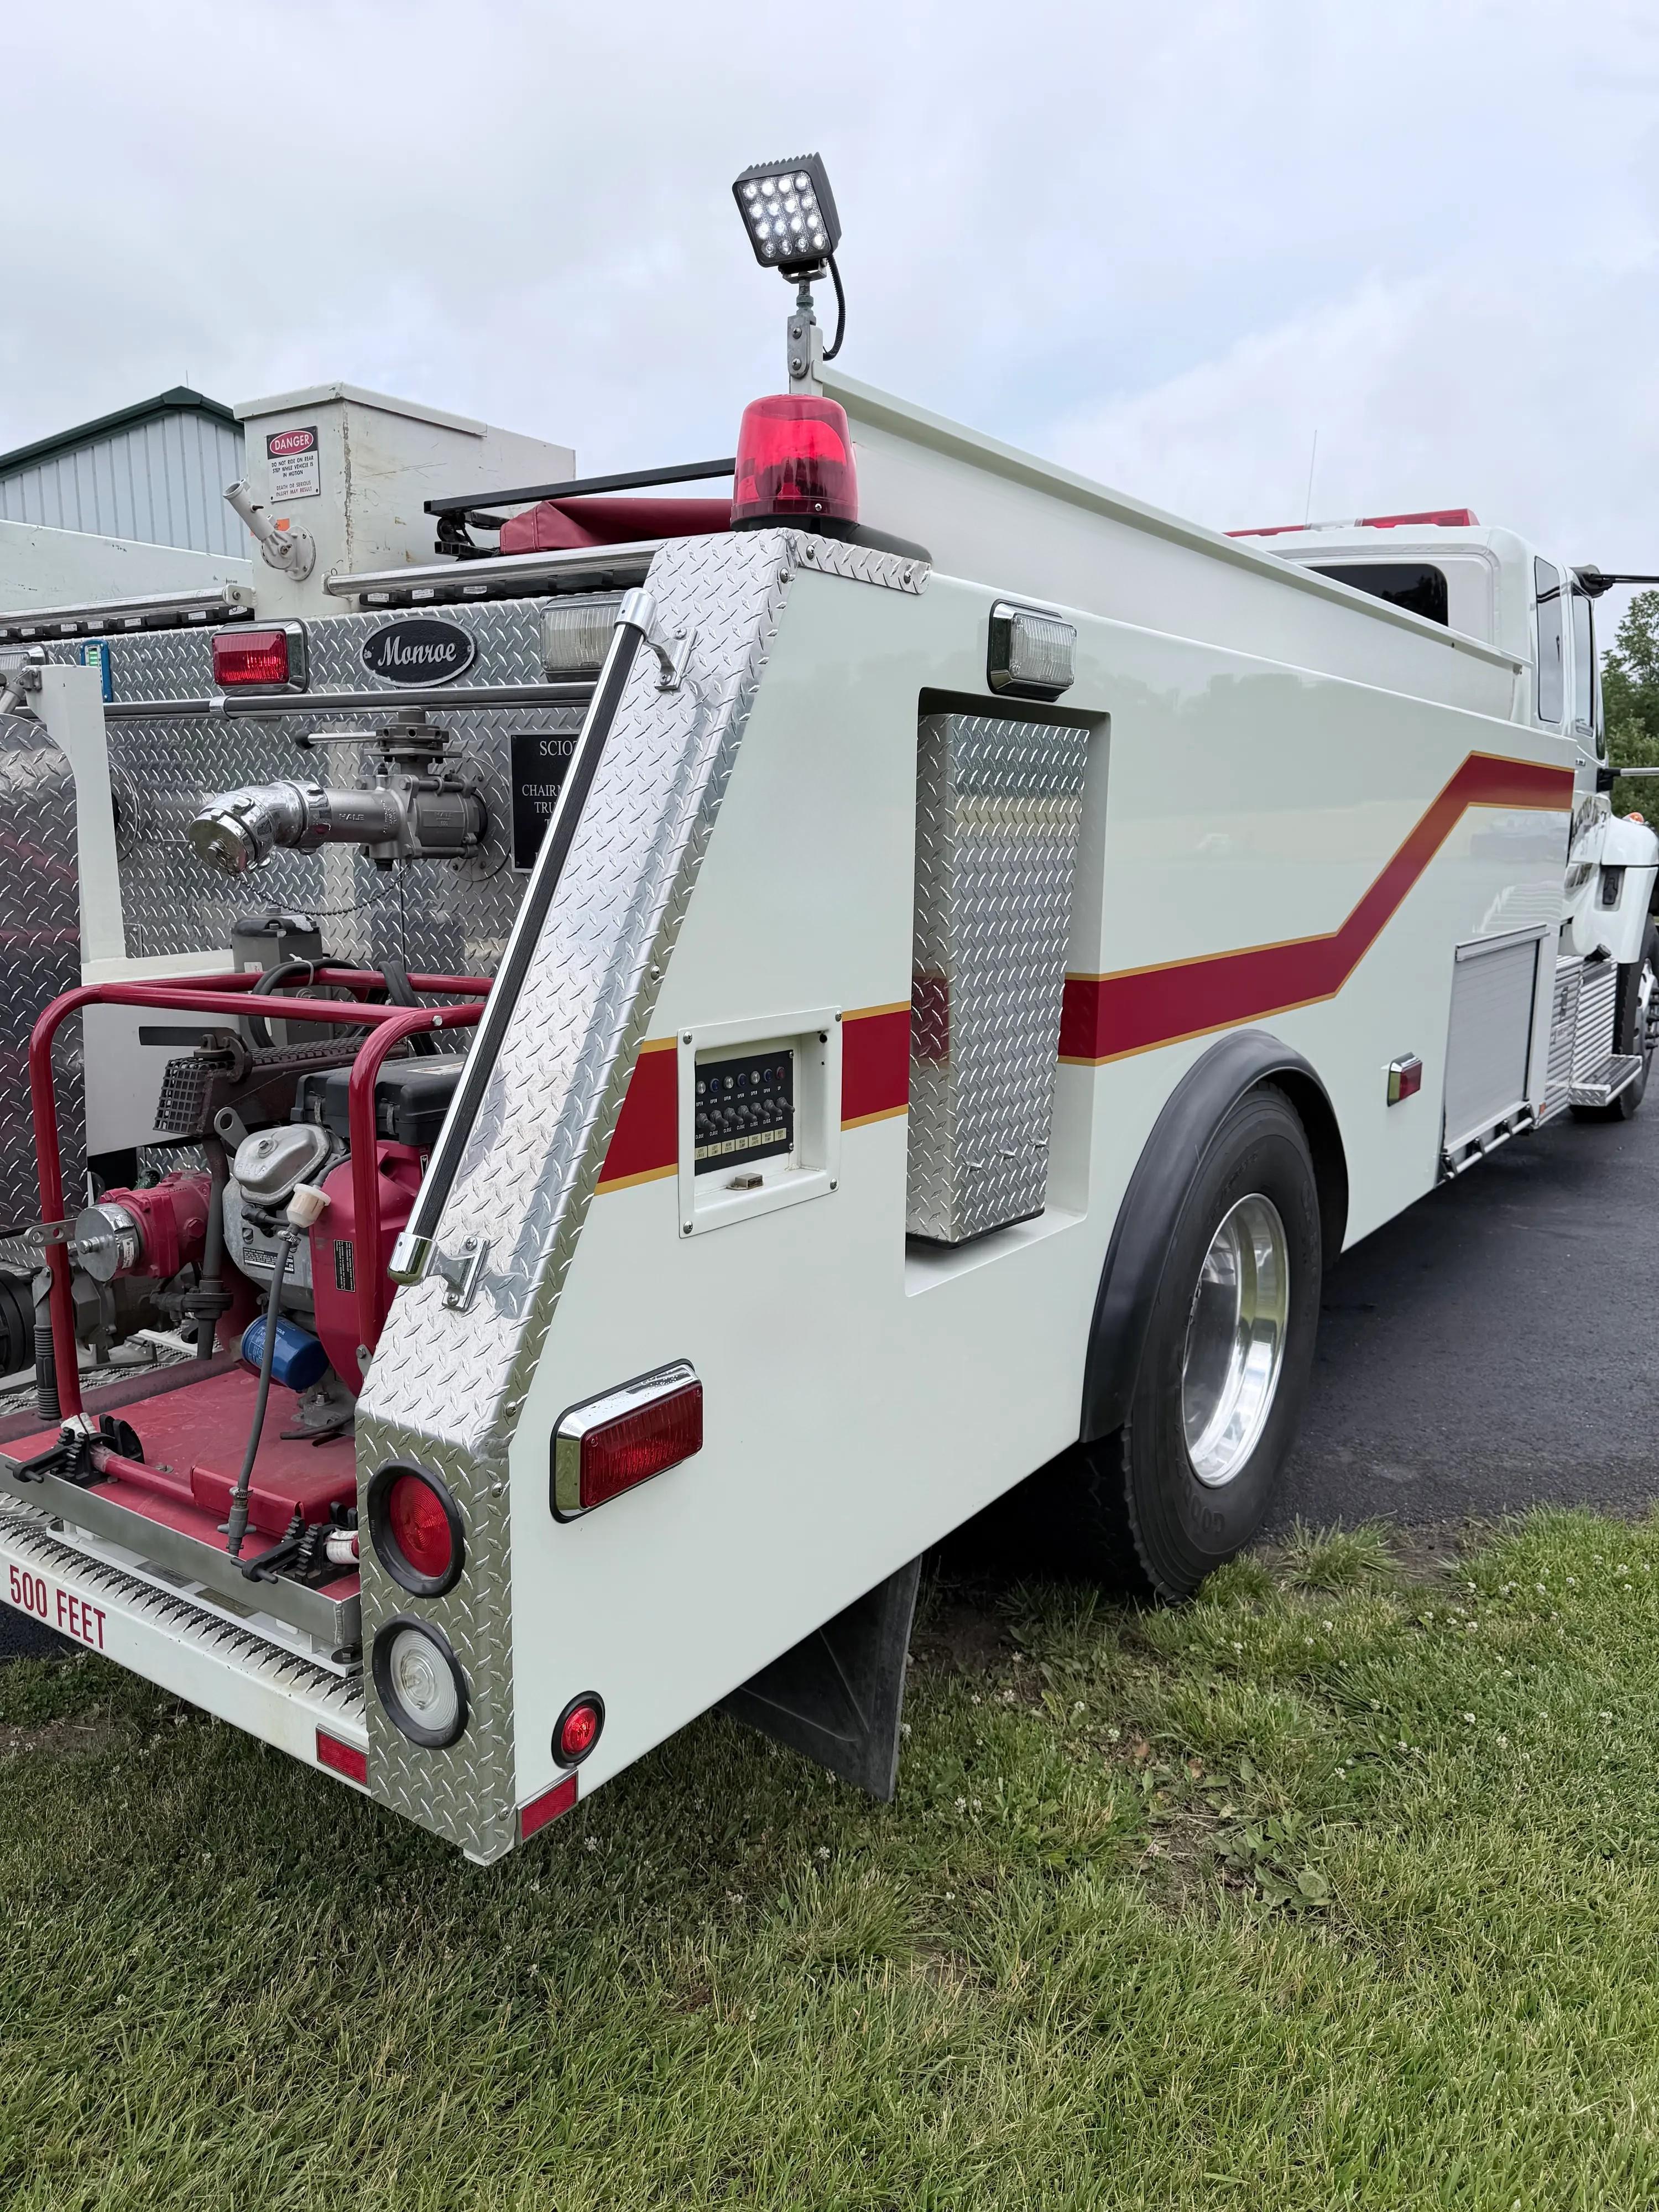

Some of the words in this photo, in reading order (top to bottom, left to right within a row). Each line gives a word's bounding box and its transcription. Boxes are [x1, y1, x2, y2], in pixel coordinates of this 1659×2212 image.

[275, 434, 310, 451] DANGER
[377, 636, 456, 666] Monroe
[540, 740, 578, 756] SCIO
[9, 1564, 48, 1618] 500
[56, 1588, 106, 1650] FEET
